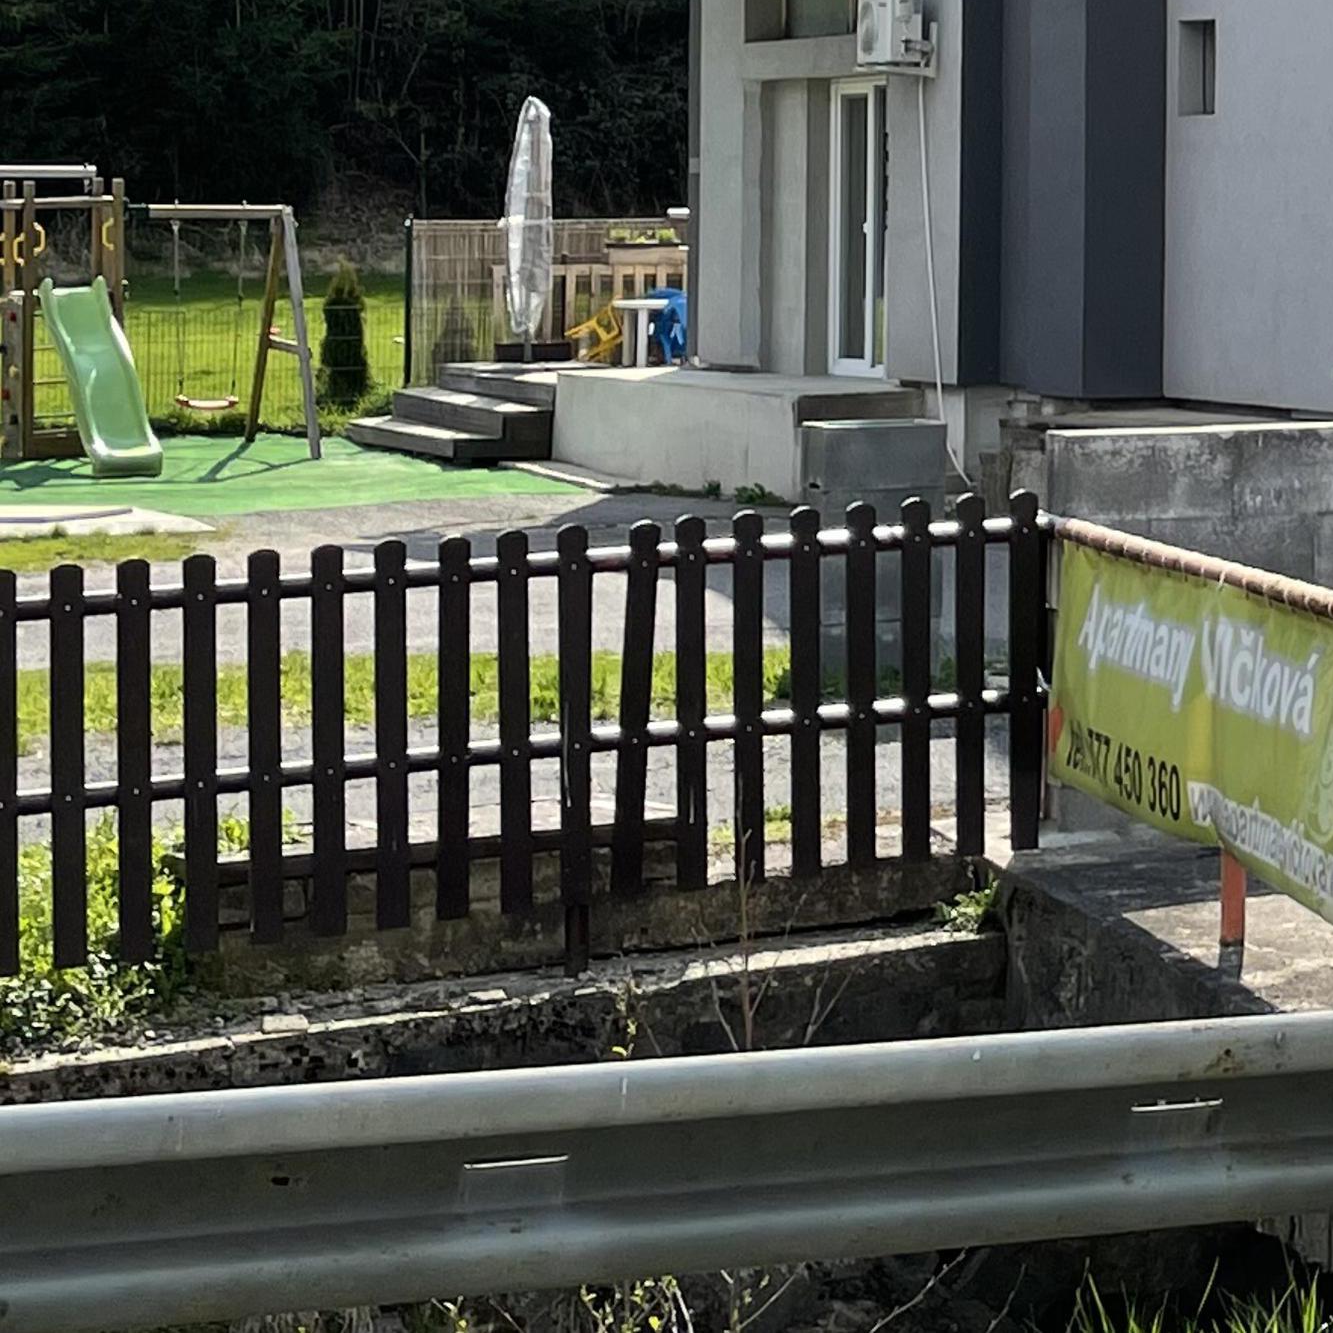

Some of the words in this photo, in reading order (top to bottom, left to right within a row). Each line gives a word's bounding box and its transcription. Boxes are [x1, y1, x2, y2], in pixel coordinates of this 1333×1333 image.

[1078, 582, 1196, 711] Apartmany
[1201, 617, 1319, 735] Vlčková
[1114, 742, 1142, 805] 450
[1147, 755, 1180, 821] 360
